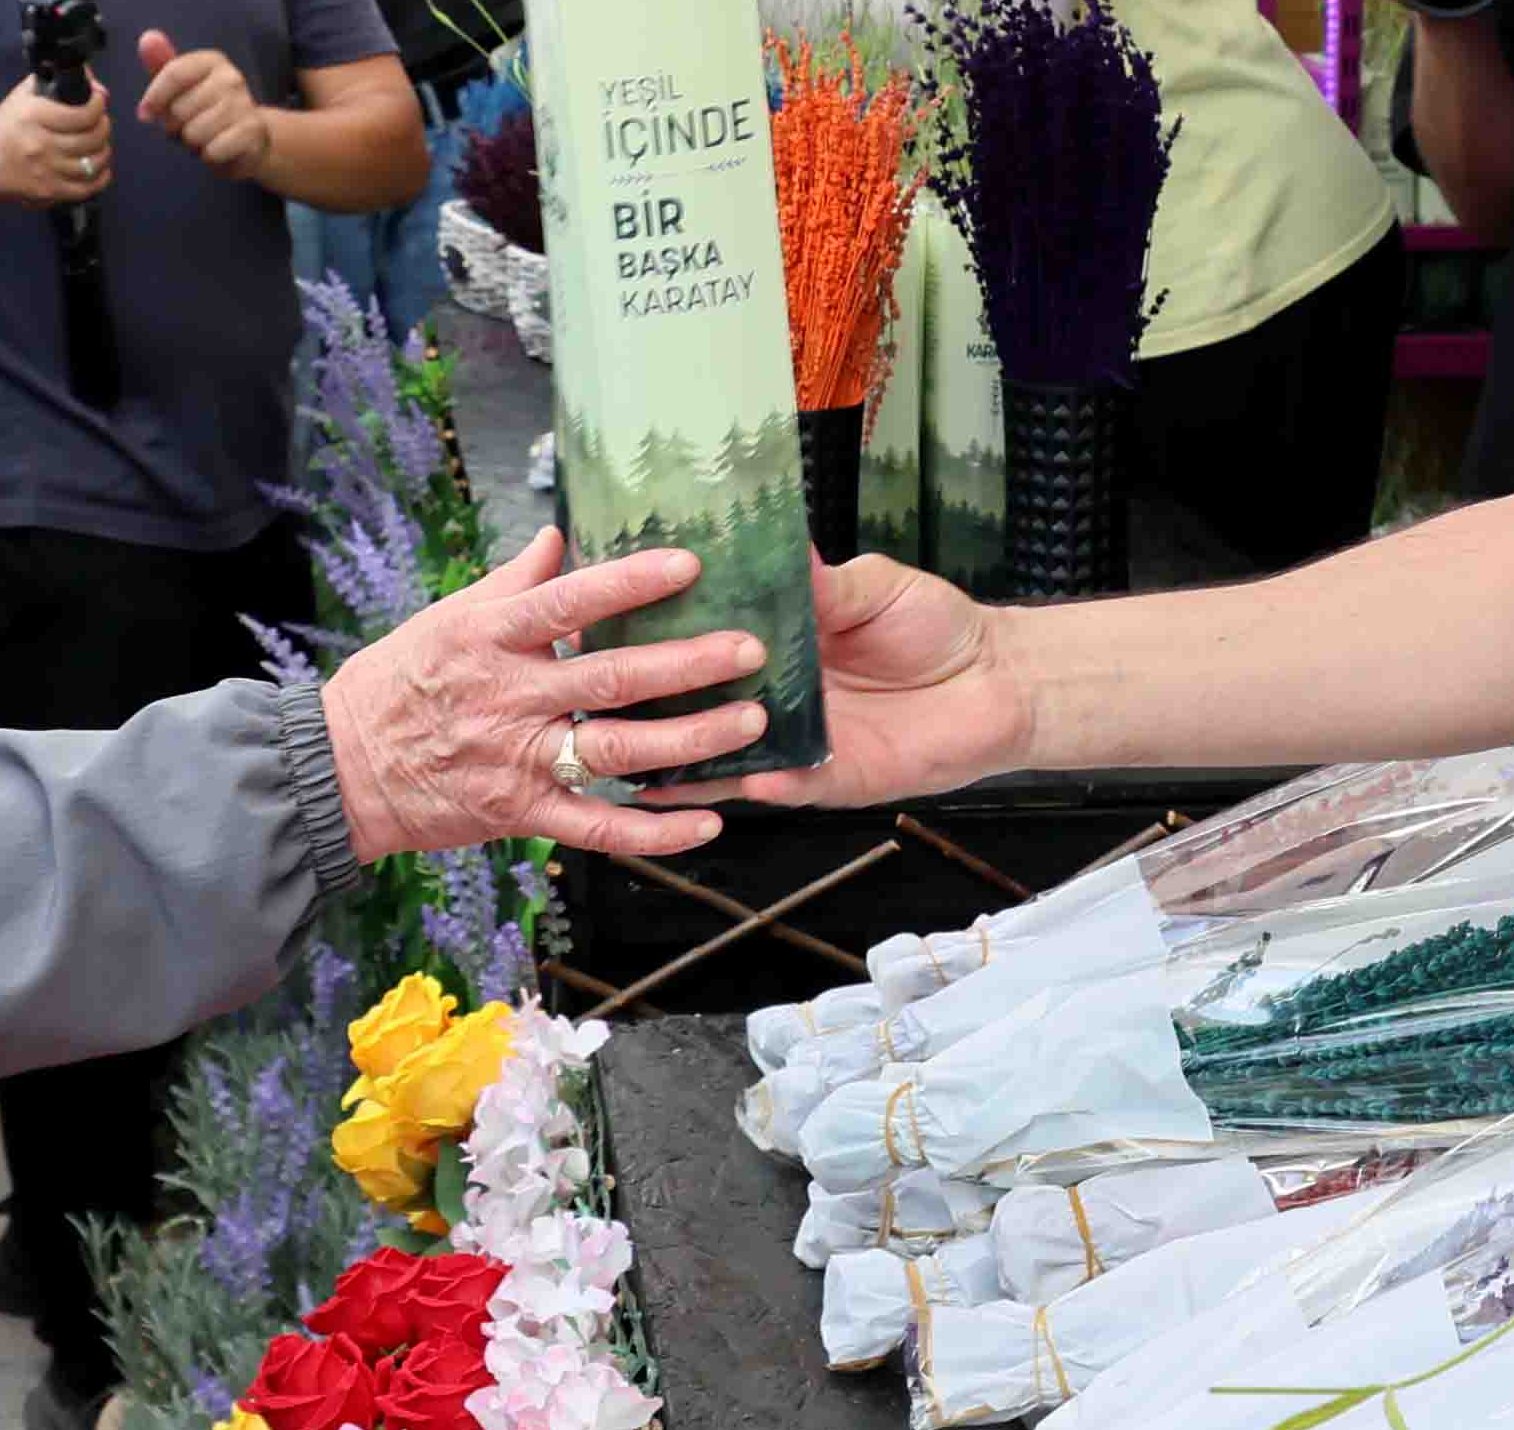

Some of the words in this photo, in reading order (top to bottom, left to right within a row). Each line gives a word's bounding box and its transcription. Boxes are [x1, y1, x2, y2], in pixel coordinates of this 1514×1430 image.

[598, 69, 685, 108] YEŞİL
[601, 98, 755, 169] İÇİNDE
[612, 188, 687, 240] BİR
[617, 240, 724, 281] BAŞKA
[620, 270, 756, 317] KARATAY
